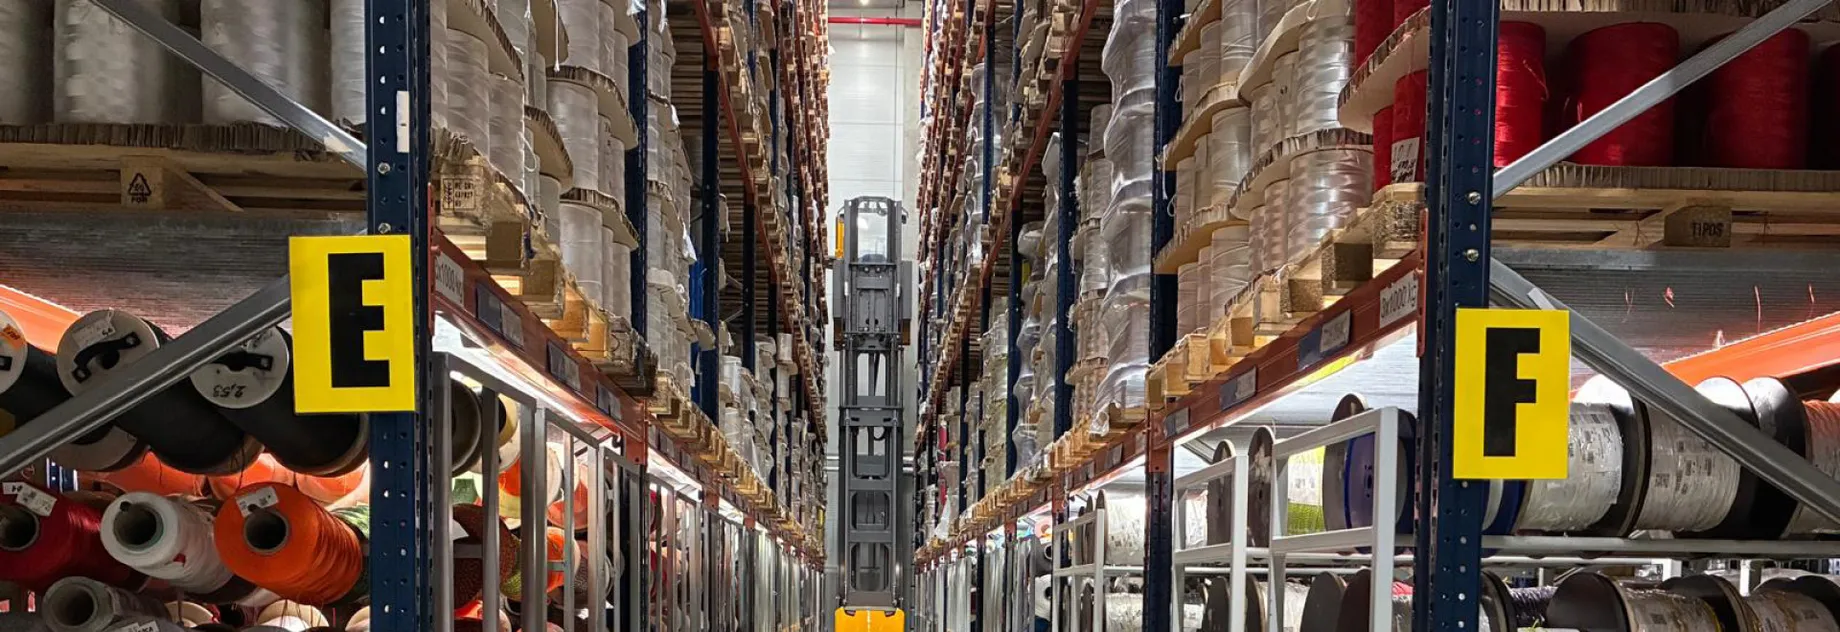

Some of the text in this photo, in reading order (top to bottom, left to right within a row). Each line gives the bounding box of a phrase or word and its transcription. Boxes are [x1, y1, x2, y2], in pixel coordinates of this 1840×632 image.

[1692, 222, 1724, 237] TIPOS
[328, 252, 390, 388] E
[213, 383, 247, 399] 2,53
[1484, 327, 1541, 457] F
